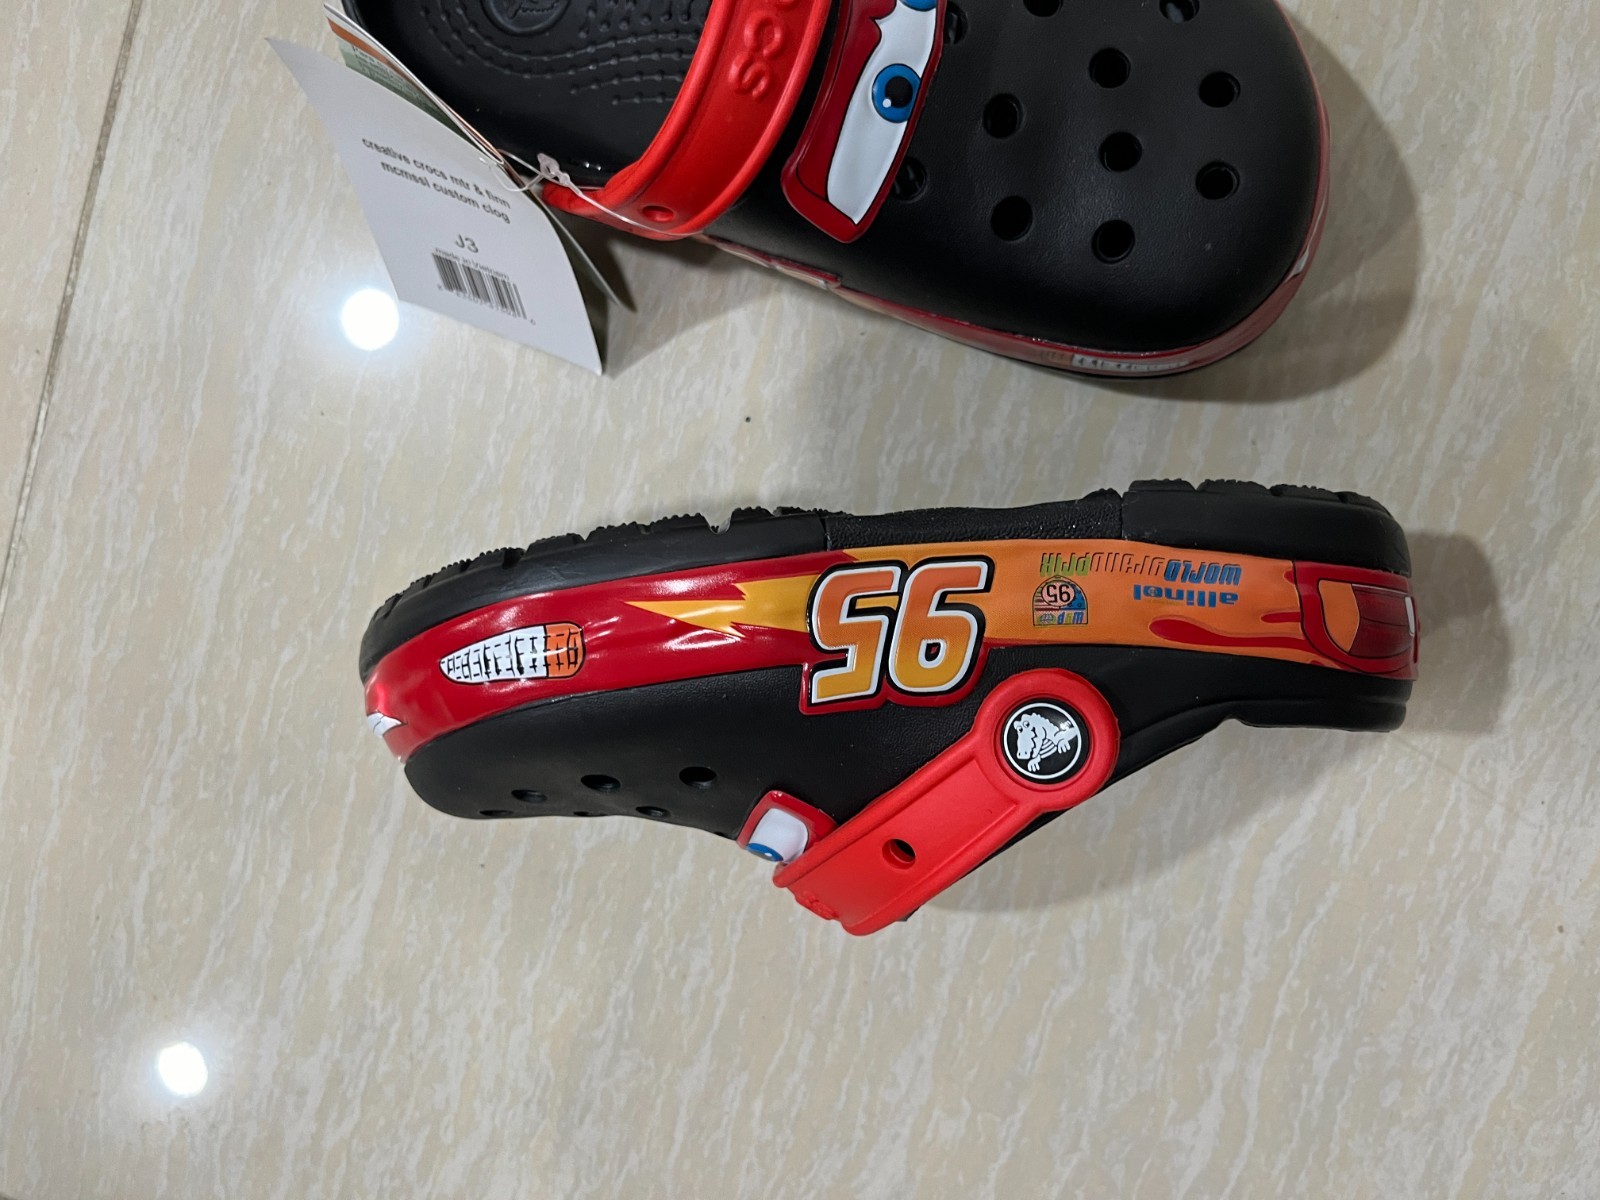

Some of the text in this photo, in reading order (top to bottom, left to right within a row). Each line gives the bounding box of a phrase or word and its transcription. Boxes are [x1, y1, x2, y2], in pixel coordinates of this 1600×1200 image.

[362, 138, 511, 208] creative crocs mtr & finn
[433, 181, 480, 208] custom
[482, 202, 510, 224] clog
[455, 234, 479, 253] J3
[1046, 584, 1072, 603] 95
[1133, 584, 1239, 607] allinol
[806, 555, 995, 706] 95
